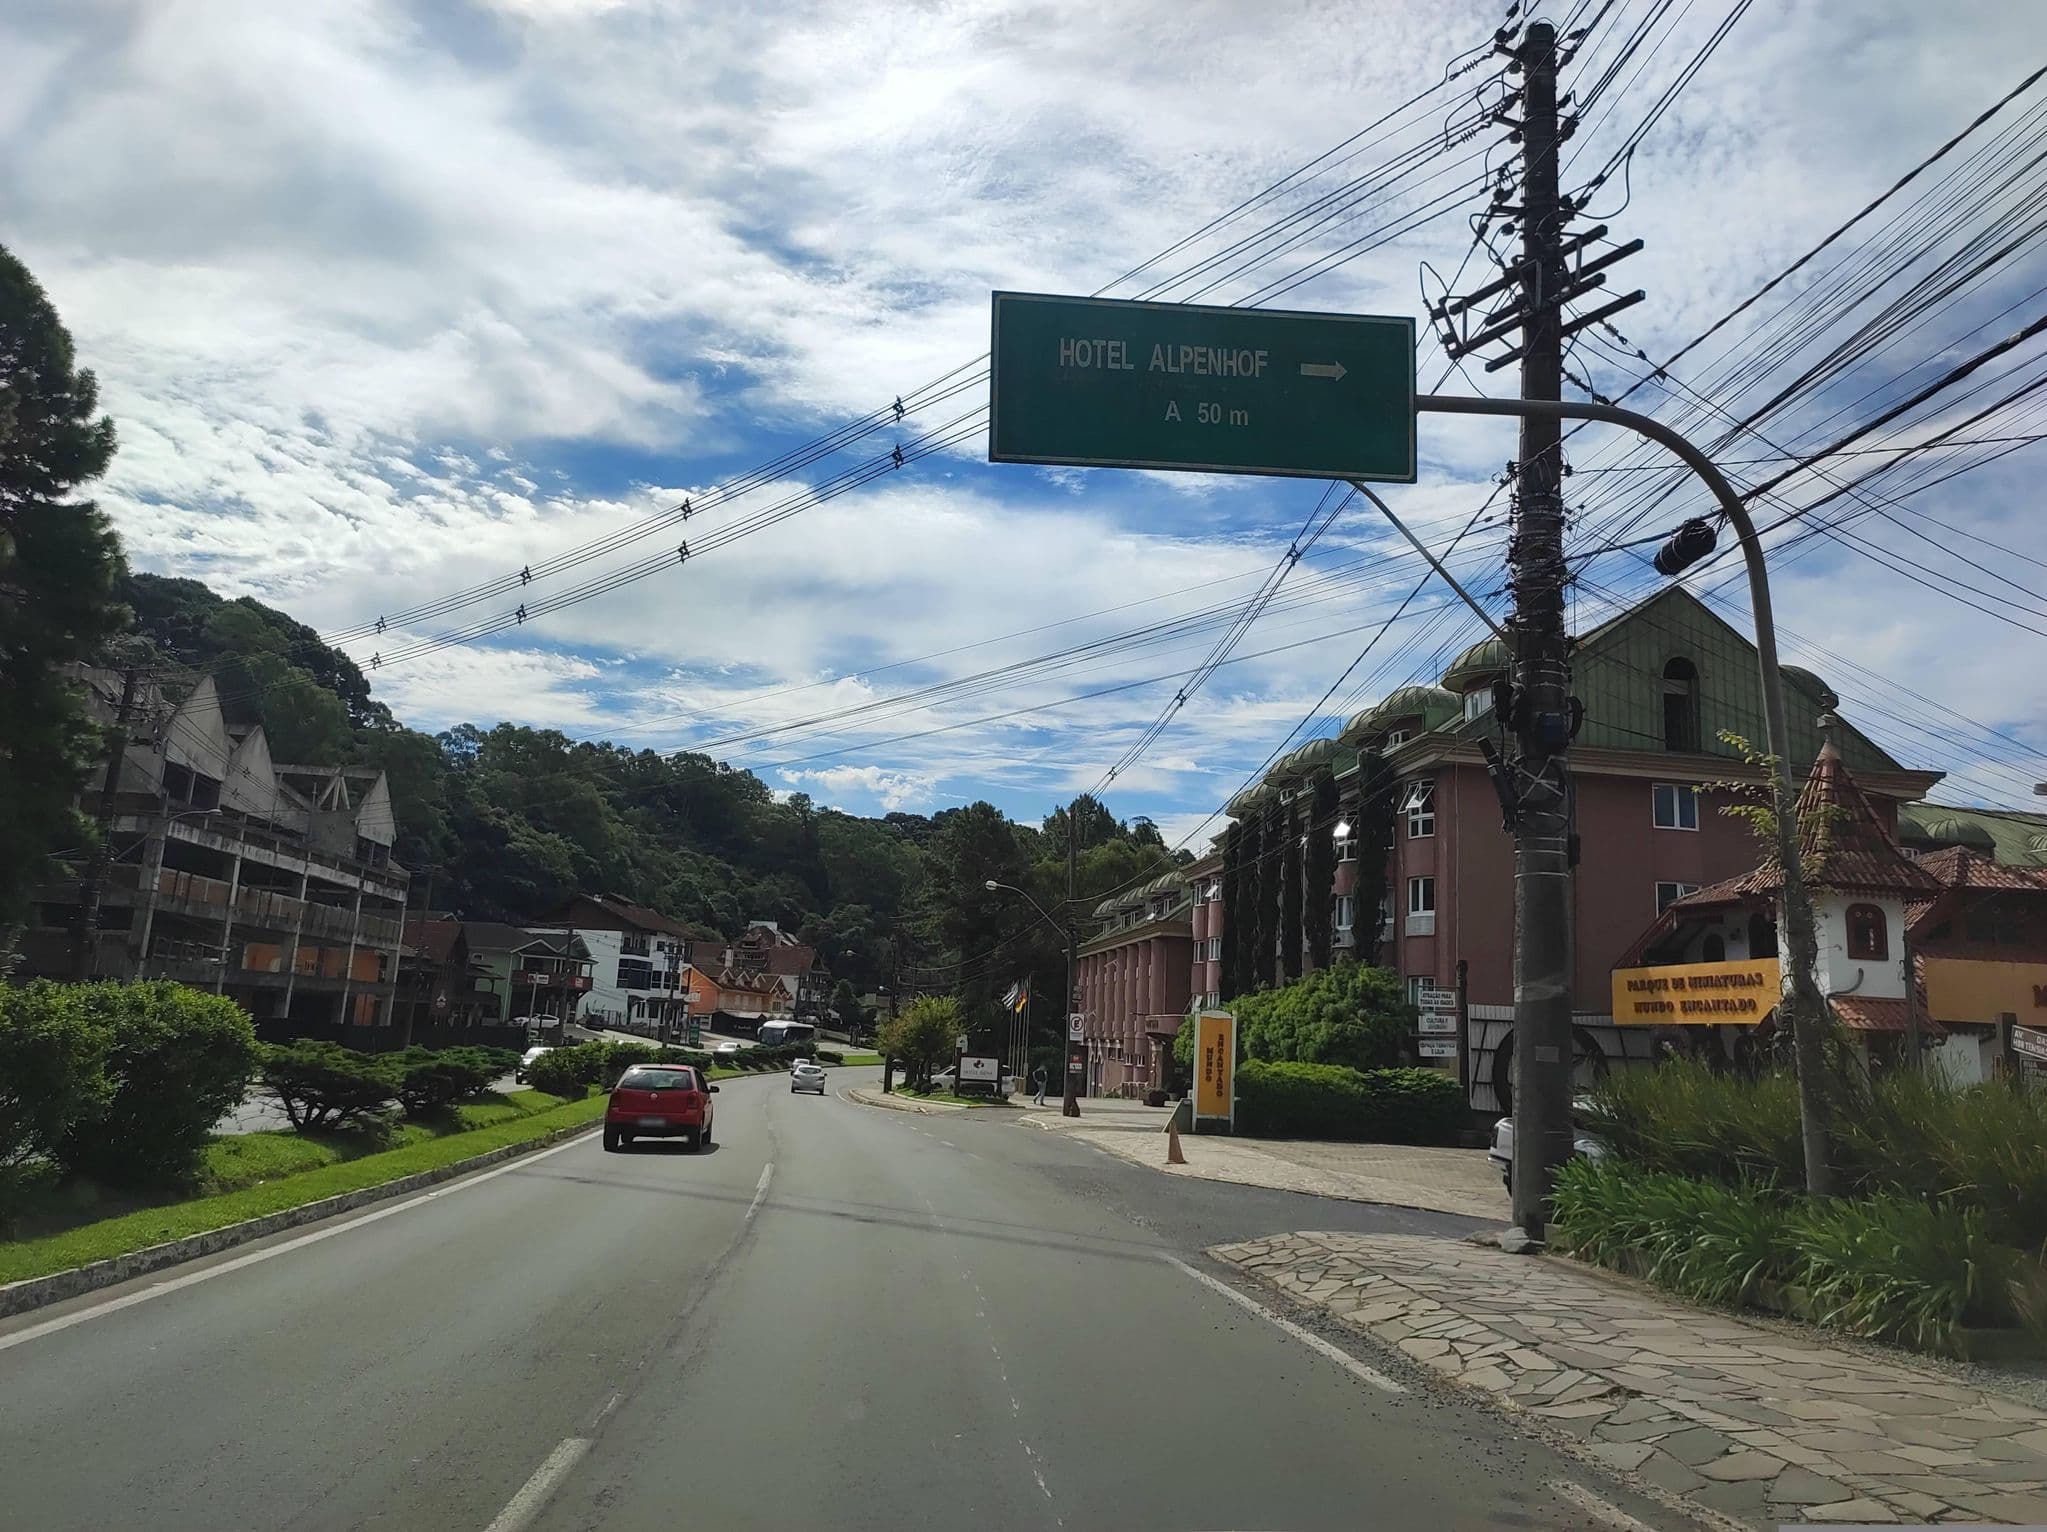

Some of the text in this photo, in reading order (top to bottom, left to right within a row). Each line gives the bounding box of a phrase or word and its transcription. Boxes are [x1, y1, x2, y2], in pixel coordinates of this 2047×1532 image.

[1059, 337, 1269, 377] HOTEL ALPENHOF
[1164, 400, 1249, 426] A 50 m
[1627, 972, 1765, 995] PARQUE DE MINIATURAS
[1634, 998, 1758, 1015] MUNDO ENCANTADO
